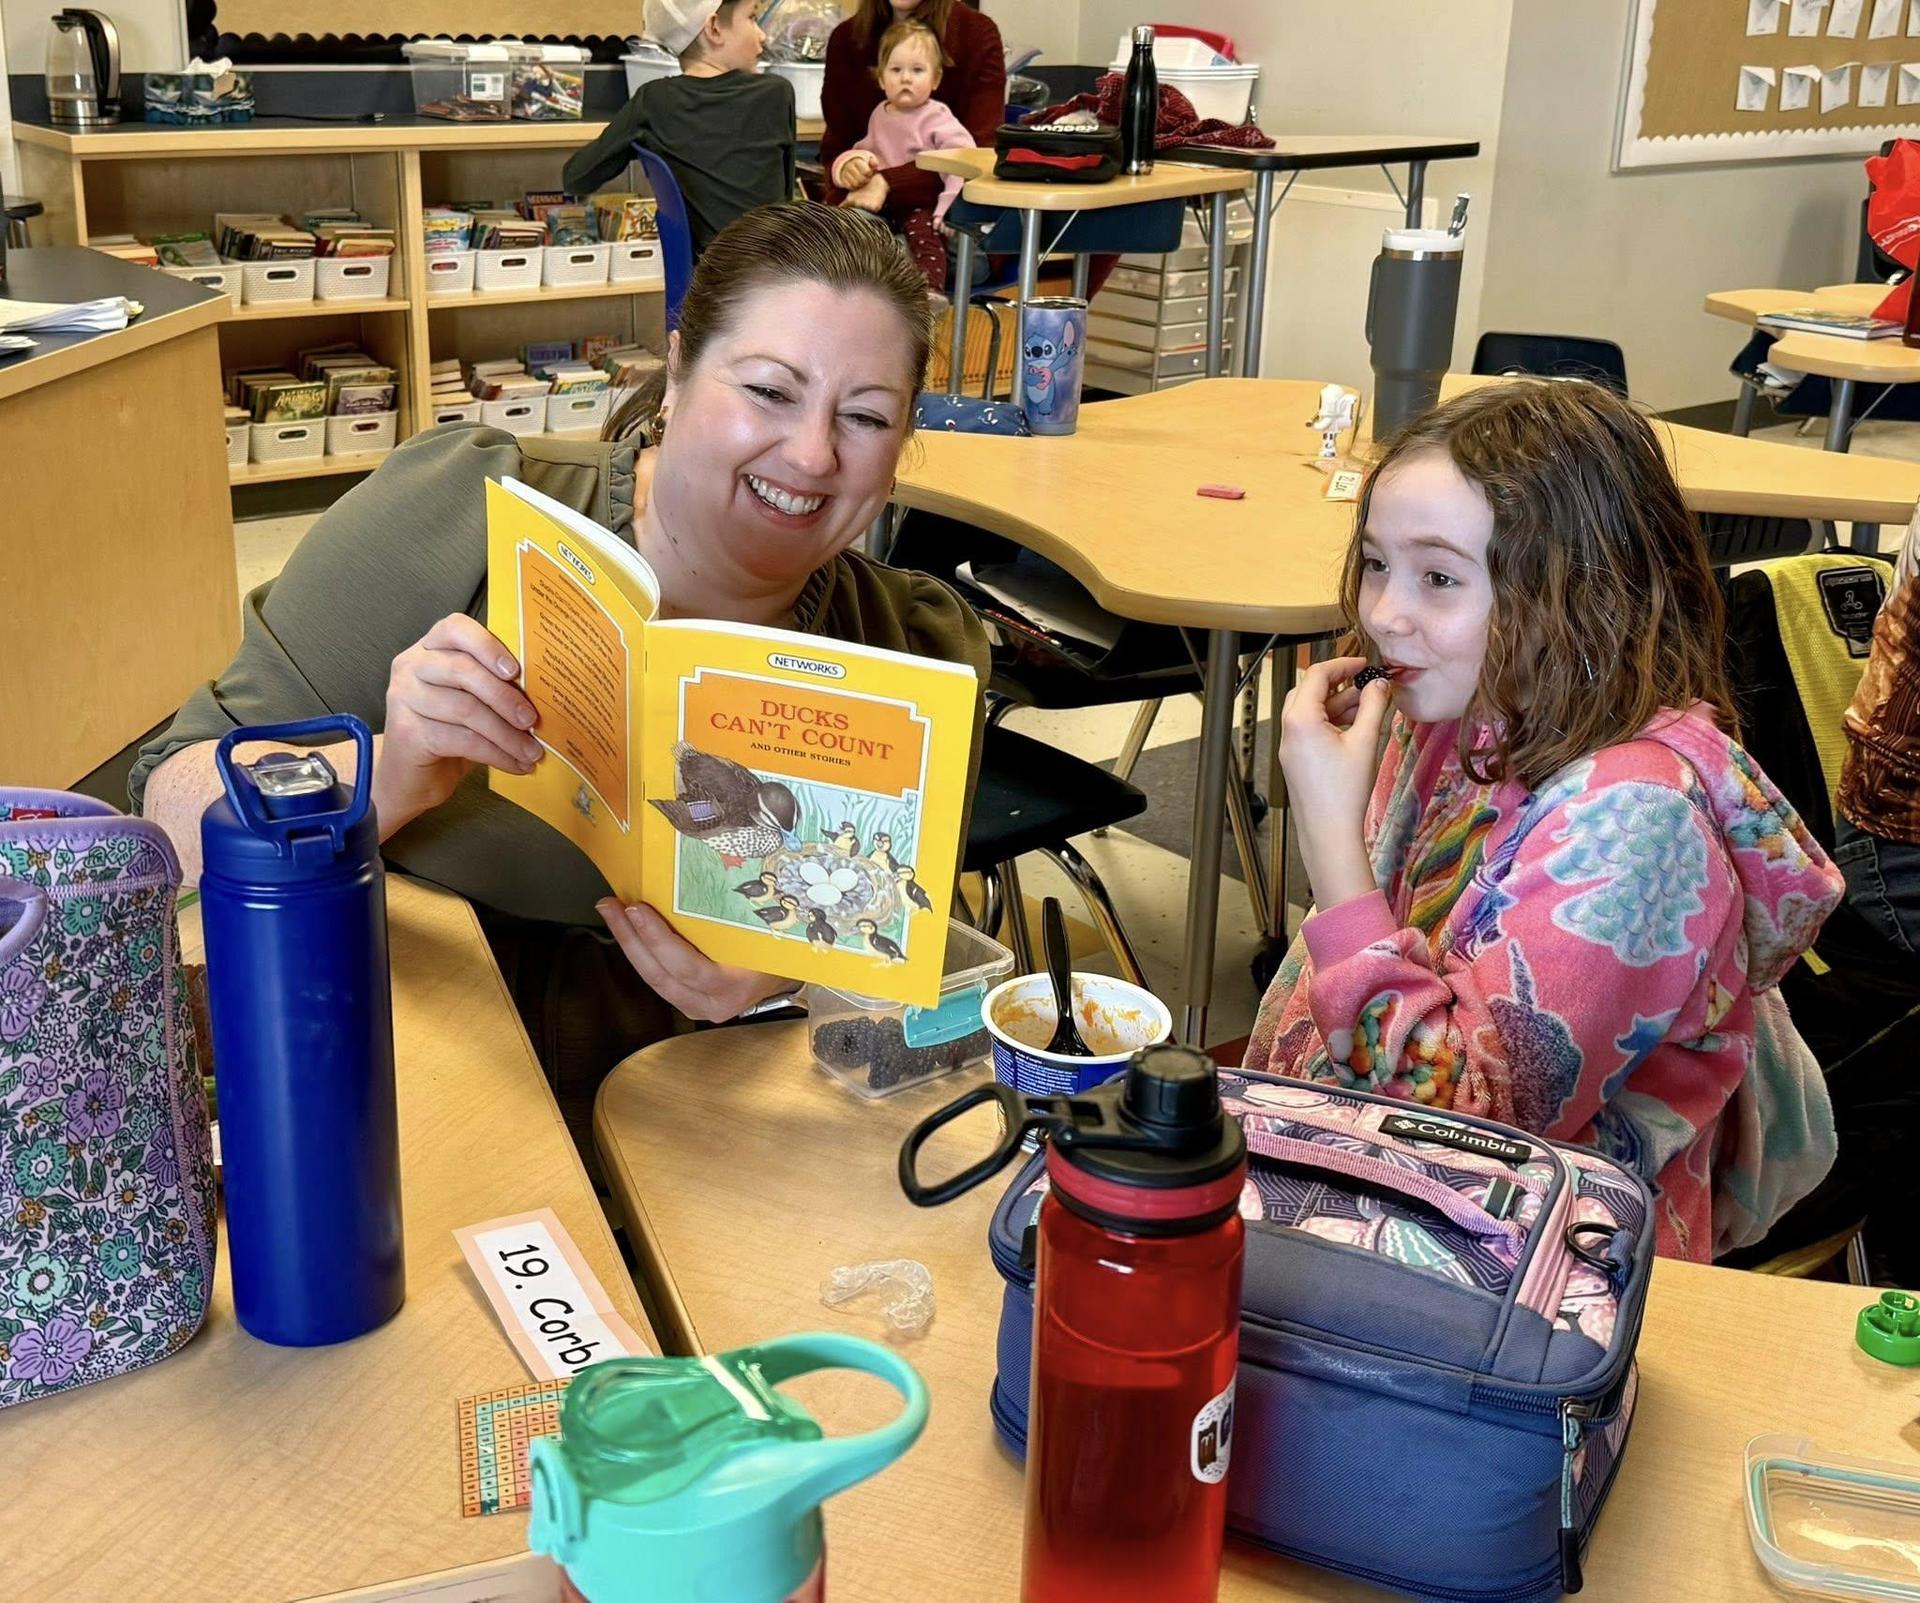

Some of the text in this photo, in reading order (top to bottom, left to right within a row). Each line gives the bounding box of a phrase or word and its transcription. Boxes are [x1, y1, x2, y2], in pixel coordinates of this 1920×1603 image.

[774, 656, 839, 675] NETWORKS
[761, 700, 849, 730] DUCKS
[710, 712, 894, 760] CAN'T COUNT
[750, 742, 851, 766] AND OTHER STORIES
[1417, 1123, 1517, 1154] Columbia
[499, 1244, 549, 1290] 19.
